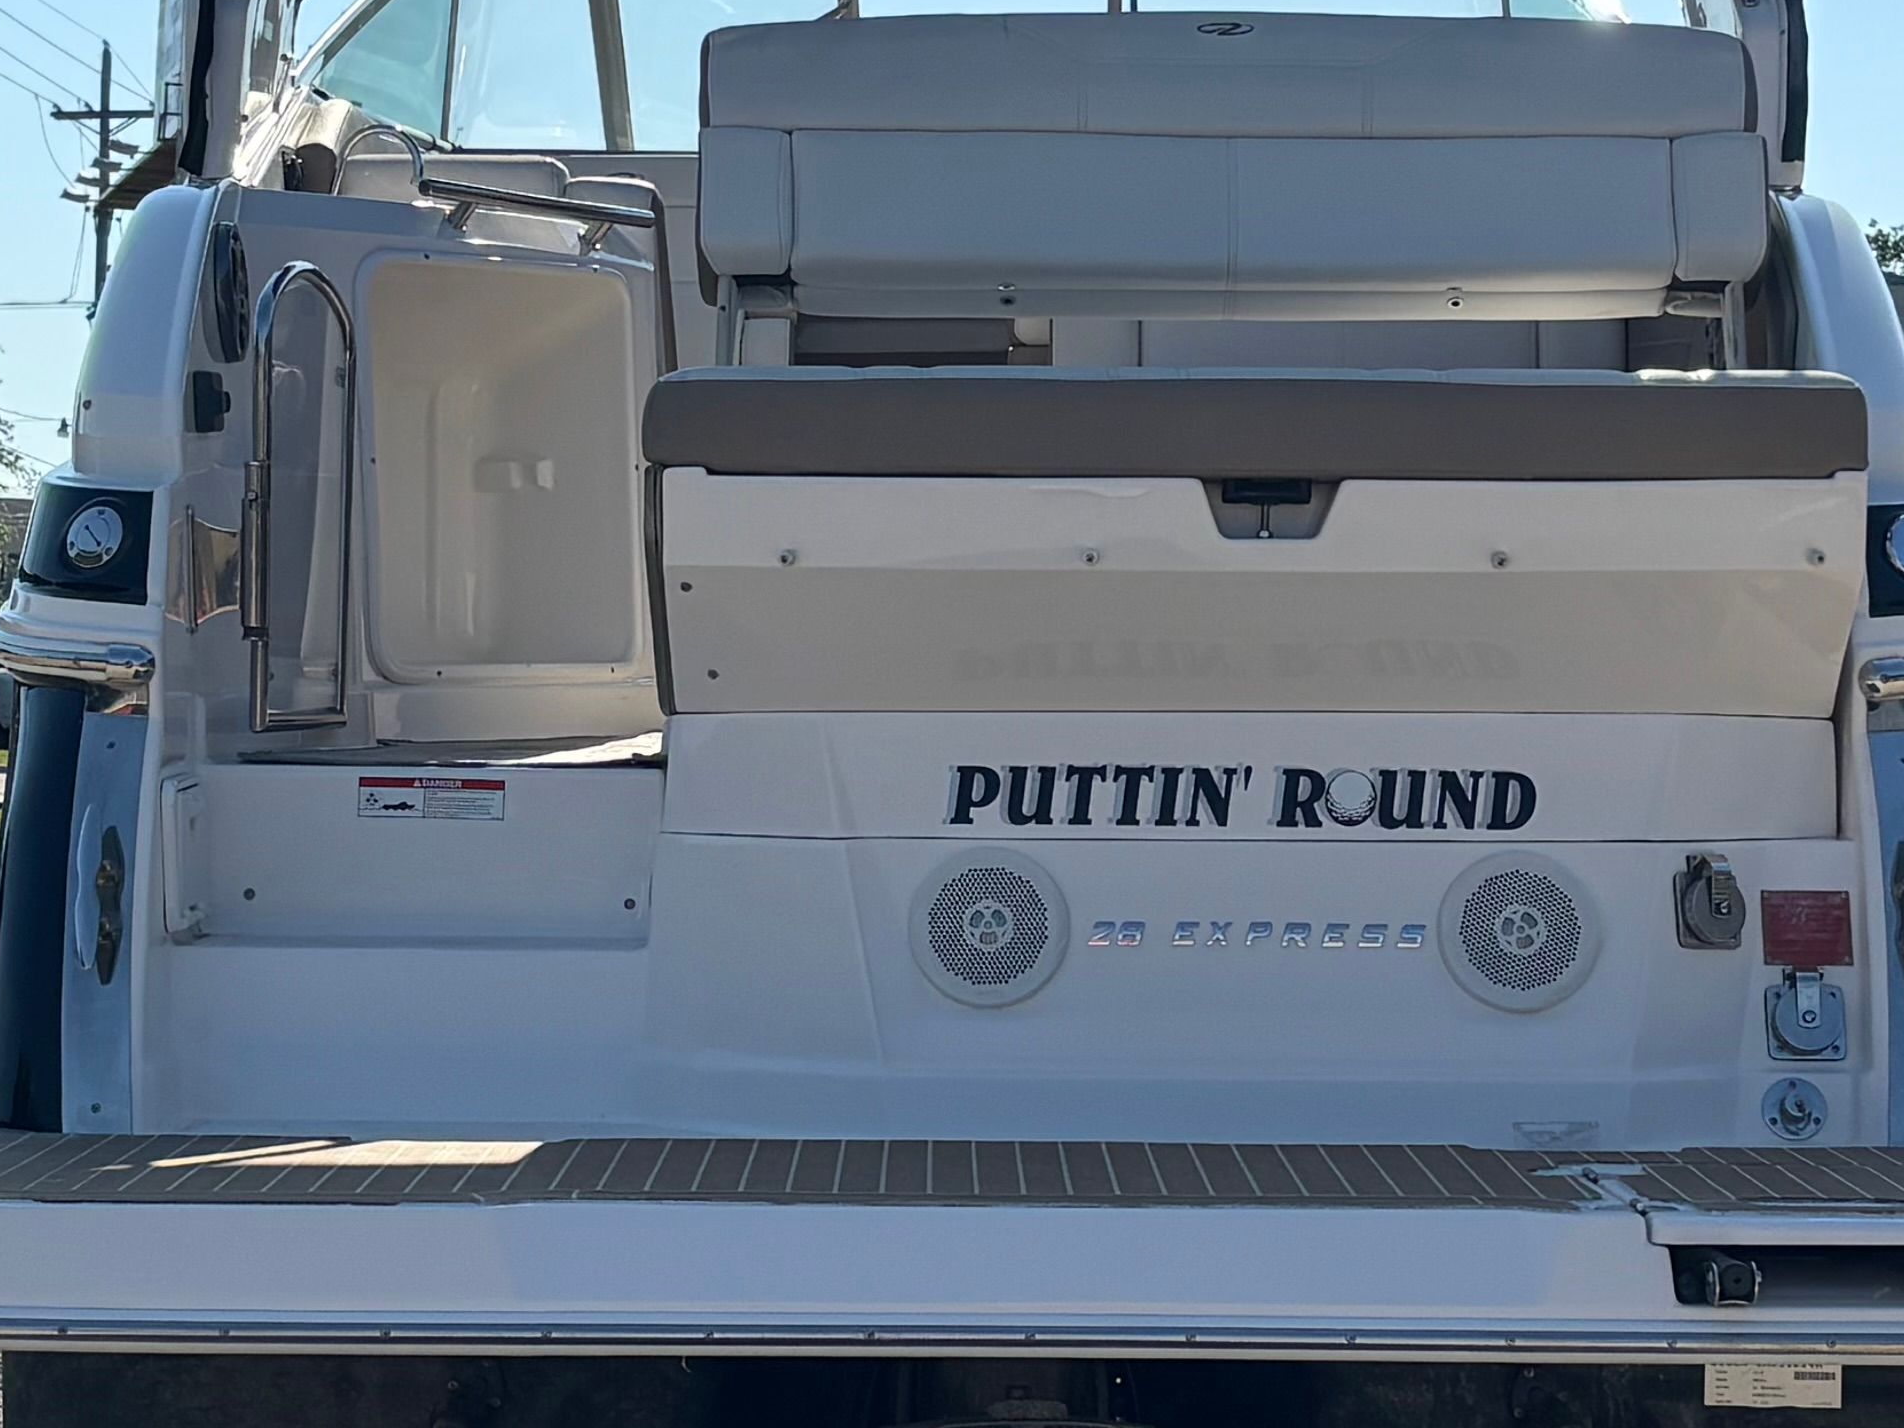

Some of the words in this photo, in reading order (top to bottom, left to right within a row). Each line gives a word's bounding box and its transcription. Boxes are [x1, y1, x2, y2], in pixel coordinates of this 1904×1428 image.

[422, 778, 463, 788] DANGER
[944, 763, 1254, 827] PUTTIN'
[1268, 766, 1538, 830] ROUND
[1087, 921, 1146, 947] 28
[1171, 921, 1427, 949] EXPRESS
